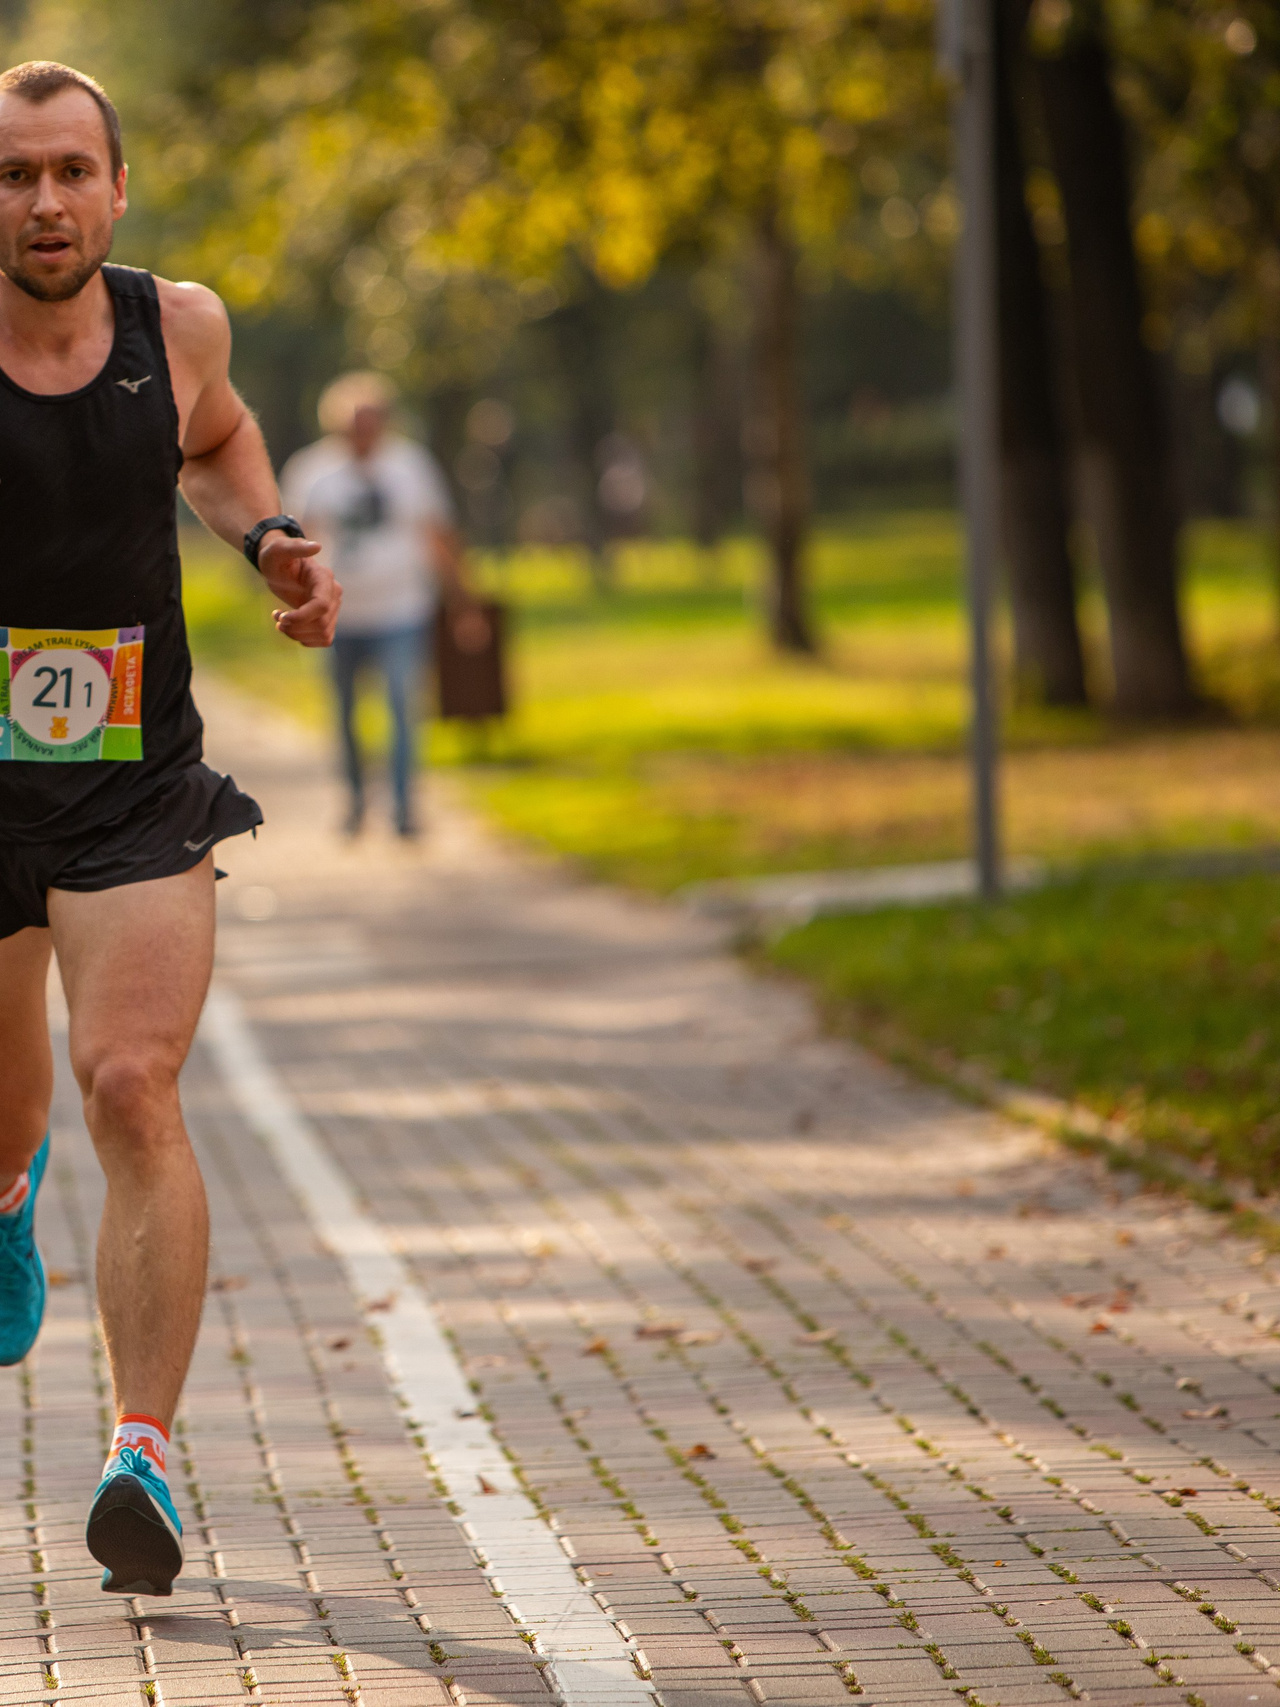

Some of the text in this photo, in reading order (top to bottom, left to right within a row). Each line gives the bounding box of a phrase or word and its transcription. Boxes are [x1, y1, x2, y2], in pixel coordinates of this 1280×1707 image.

[12, 637, 109, 666] DREAM TRAIL LYSKOVO
[0, 678, 10, 702] TRAIL
[32, 666, 92, 708] 21 1
[123, 656, 136, 716] ЭСТАФЕТА
